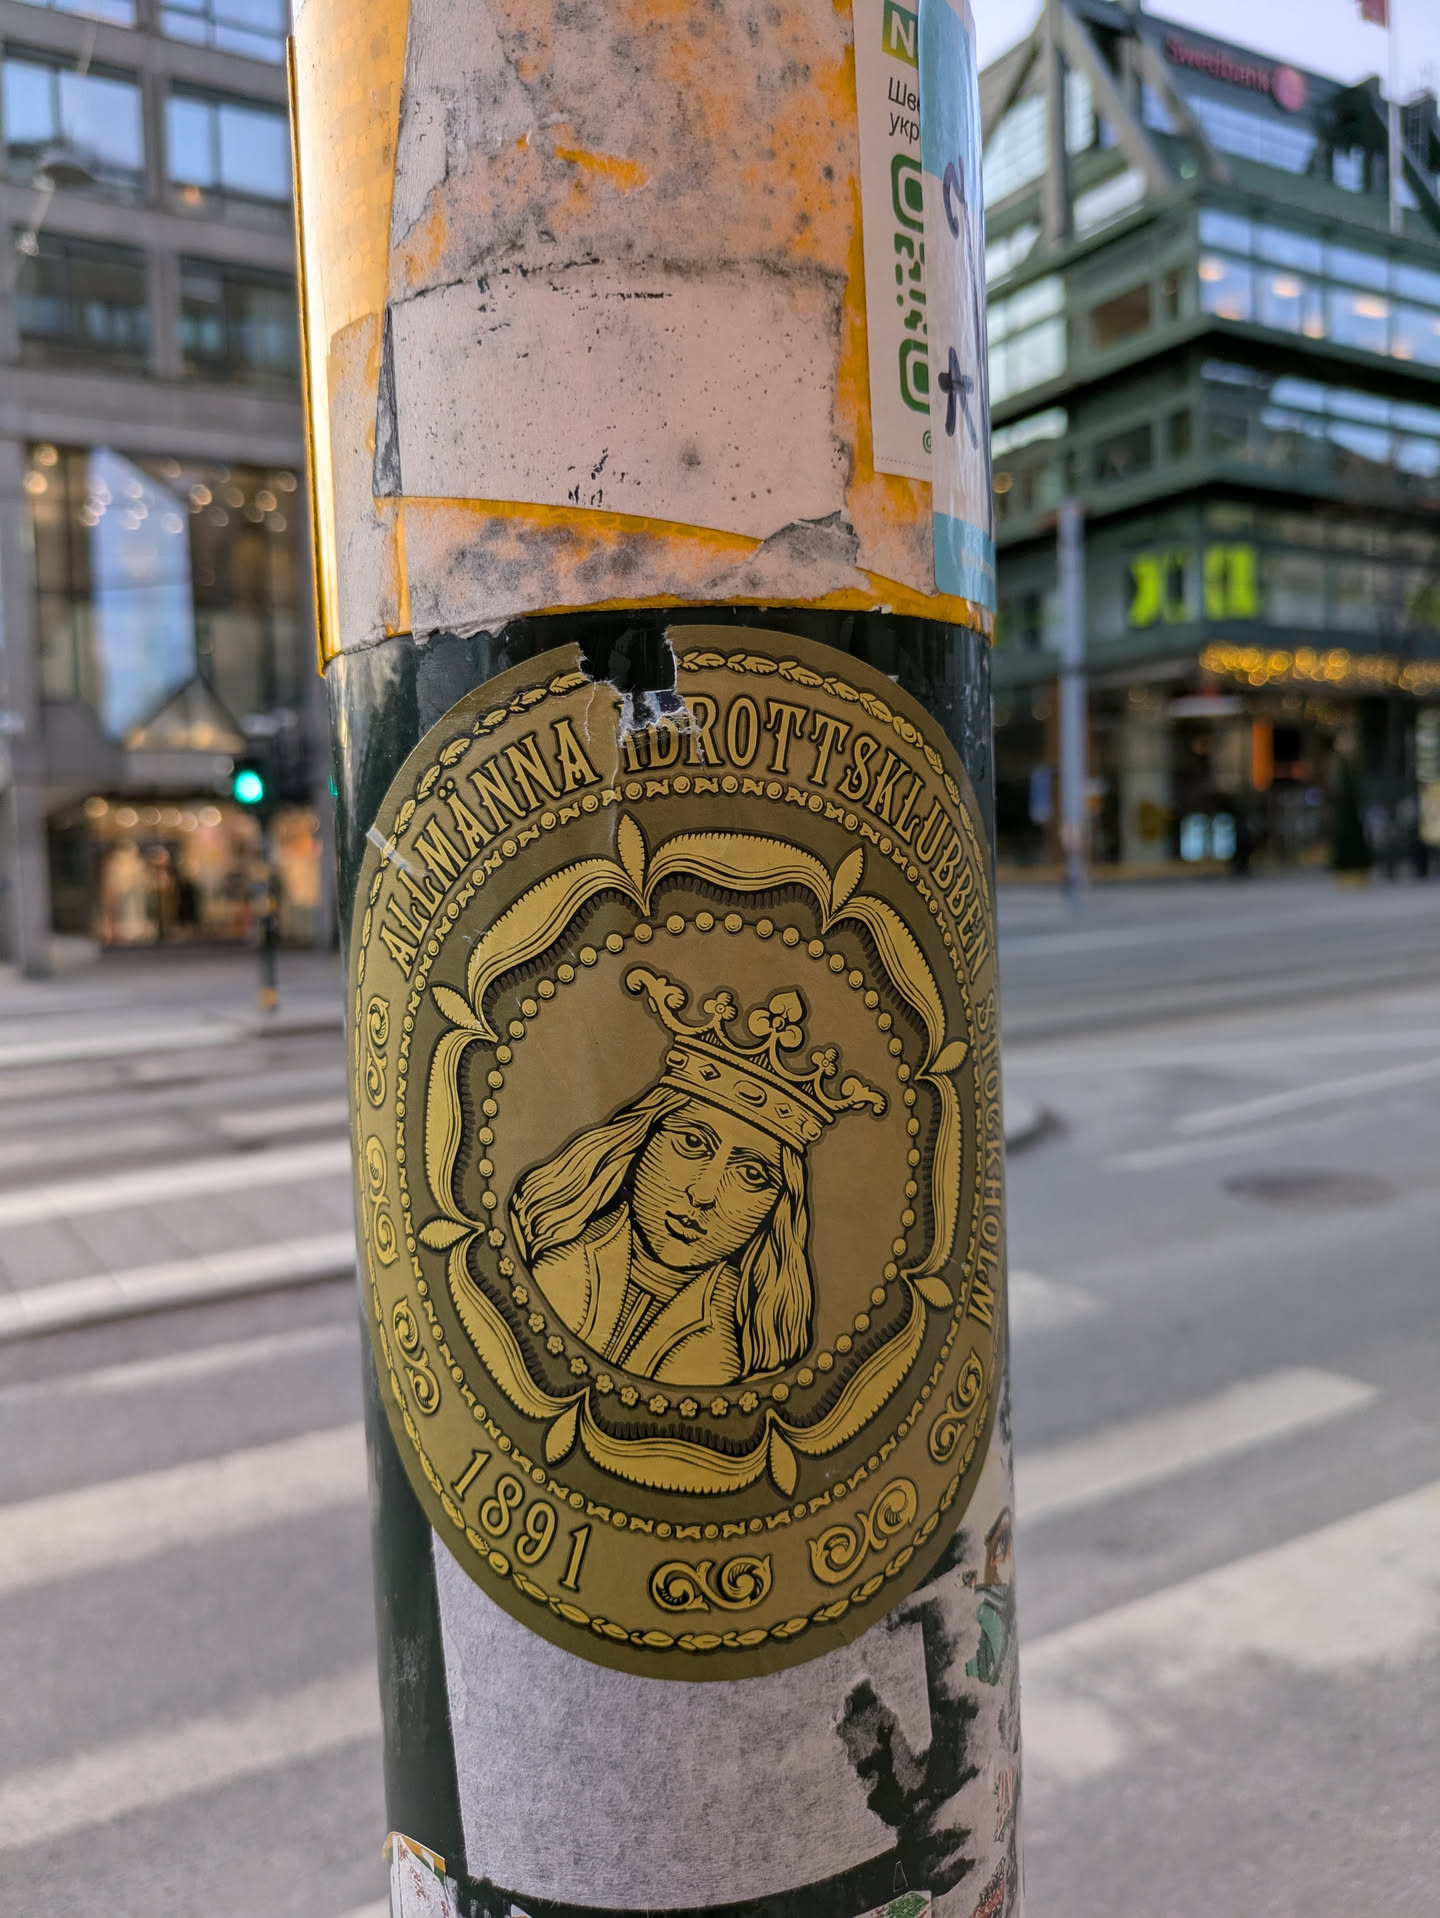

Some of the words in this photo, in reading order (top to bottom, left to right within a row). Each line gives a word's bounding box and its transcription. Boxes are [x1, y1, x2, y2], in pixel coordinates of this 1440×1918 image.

[378, 716, 602, 982] ALLMÄNNA
[619, 693, 991, 984] IDROTTSKLUBBEN
[966, 990, 1004, 1331] STOCKHOLM
[451, 1449, 592, 1593] 1891
